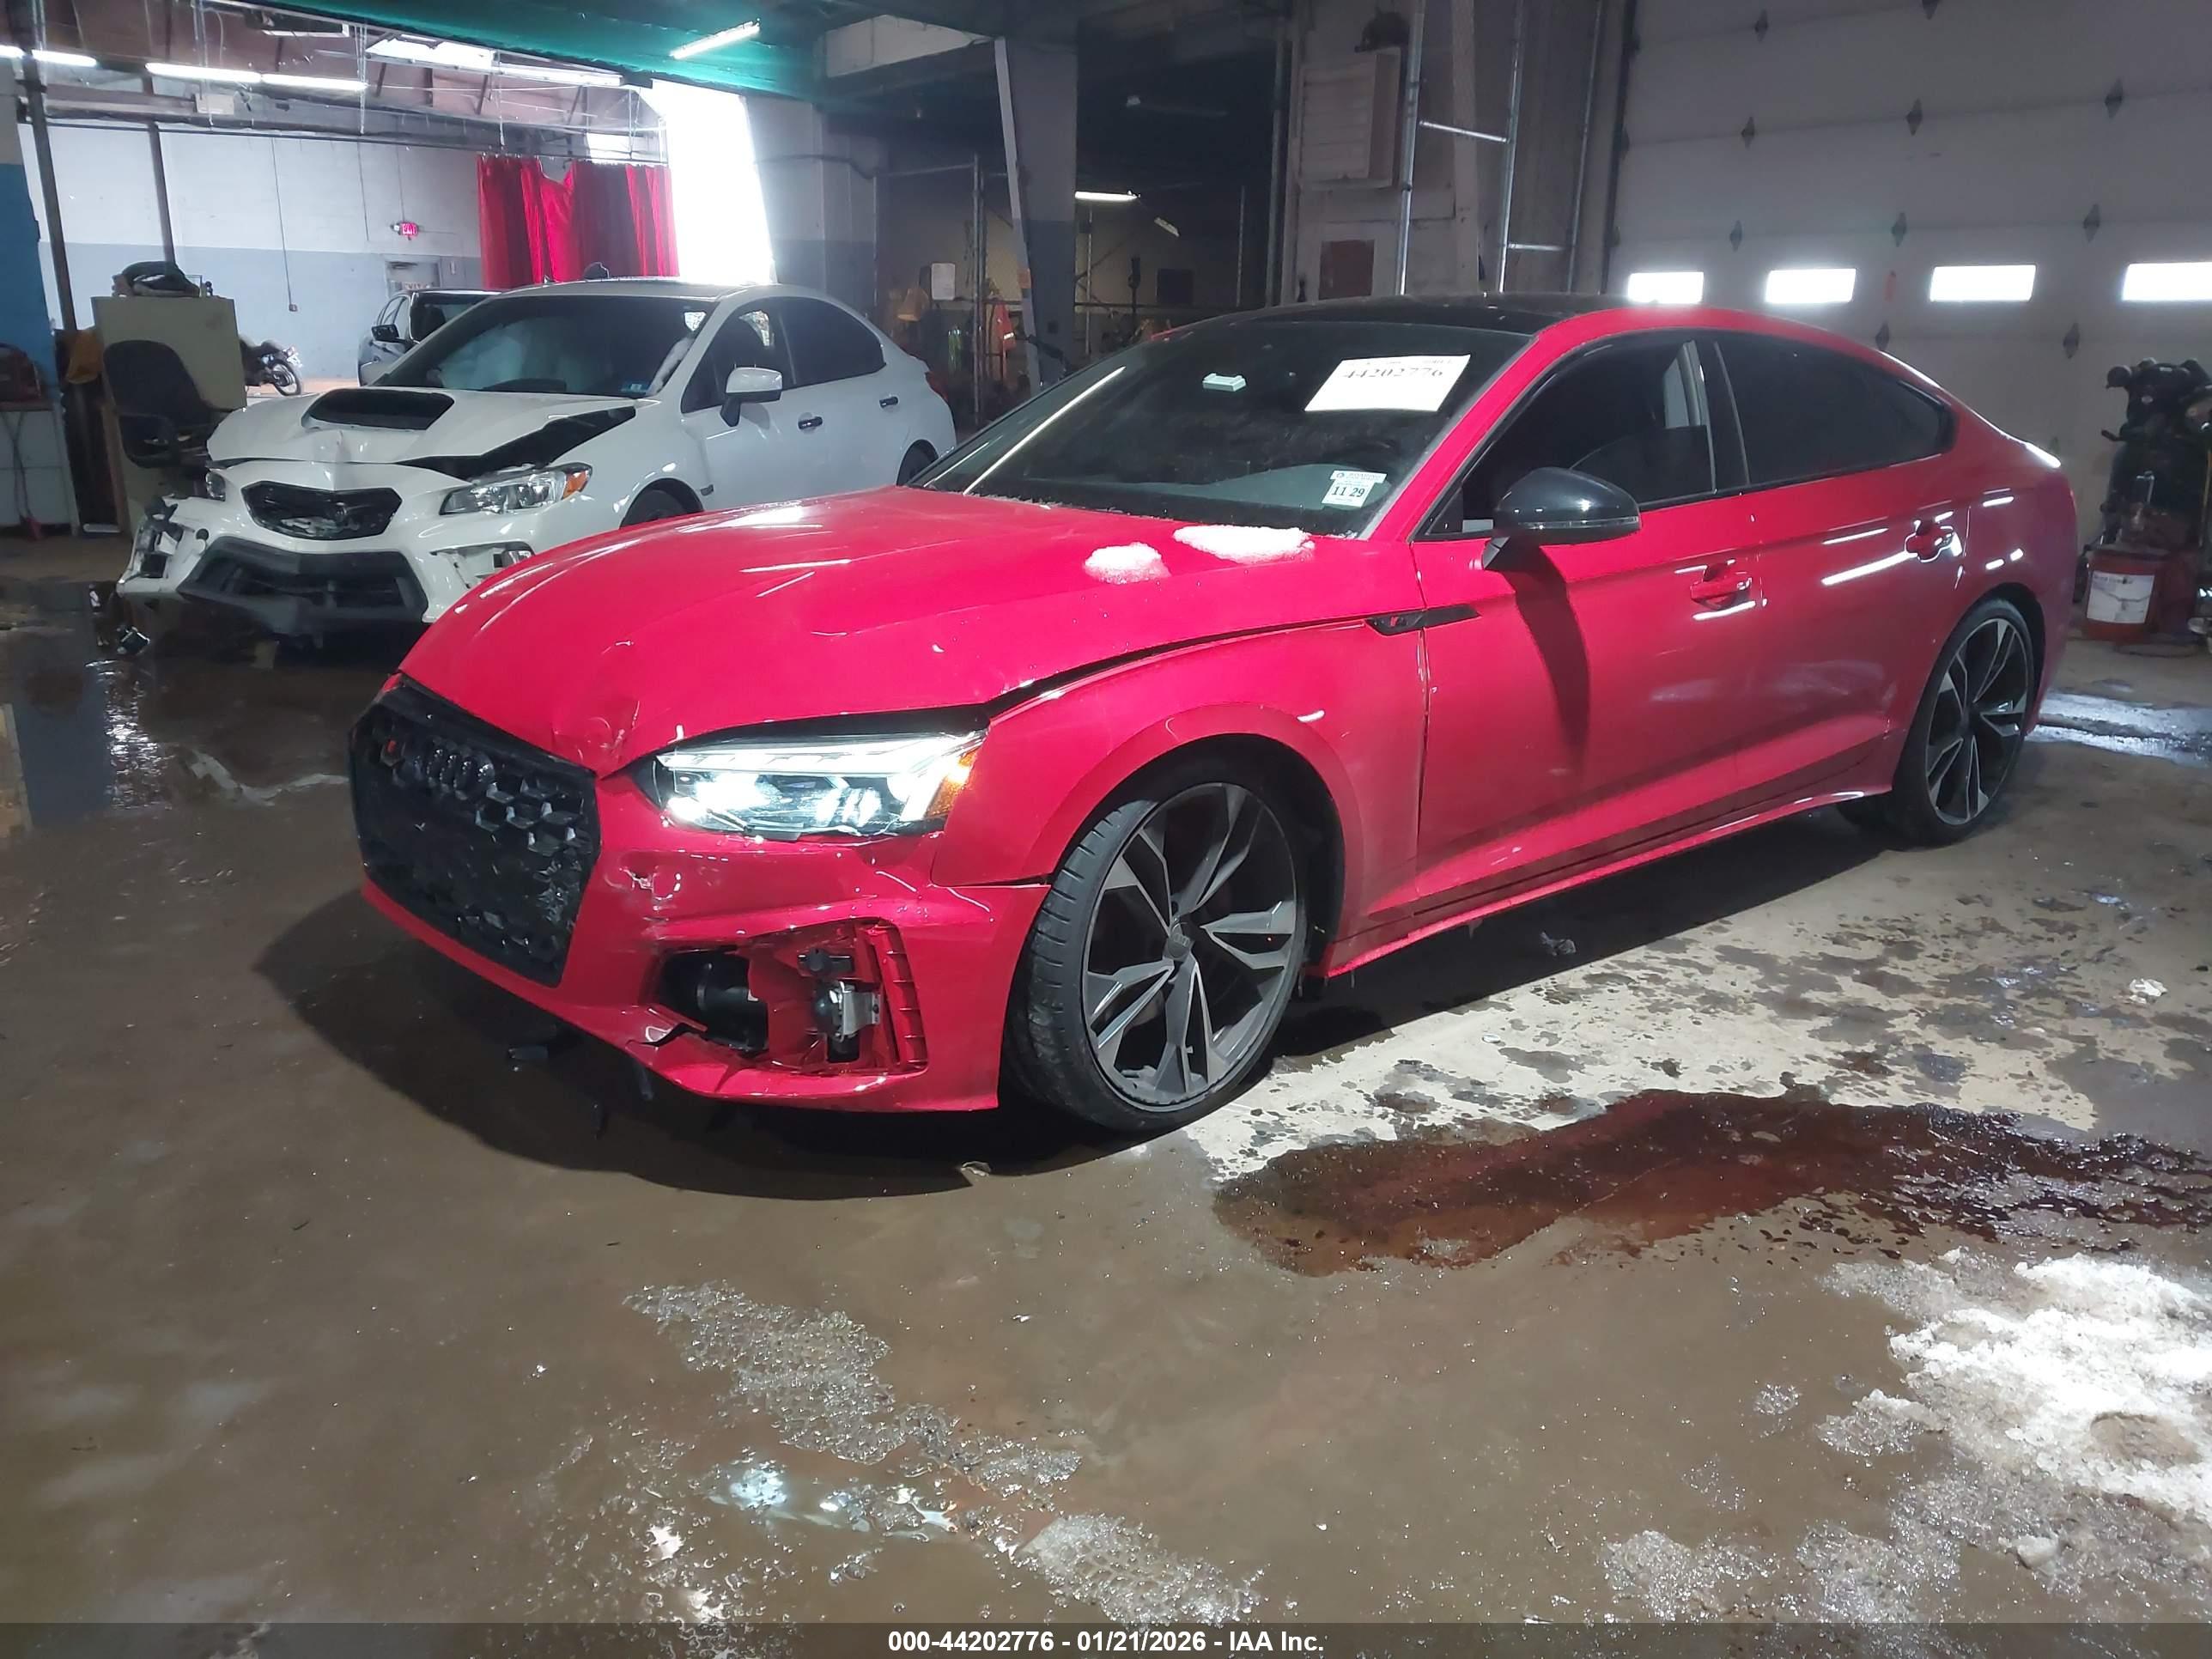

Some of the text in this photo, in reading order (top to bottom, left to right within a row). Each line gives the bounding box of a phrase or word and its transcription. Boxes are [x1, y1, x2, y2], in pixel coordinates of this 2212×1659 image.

[1342, 367, 1443, 379] 44202776
[1331, 486, 1366, 498] 11 29
